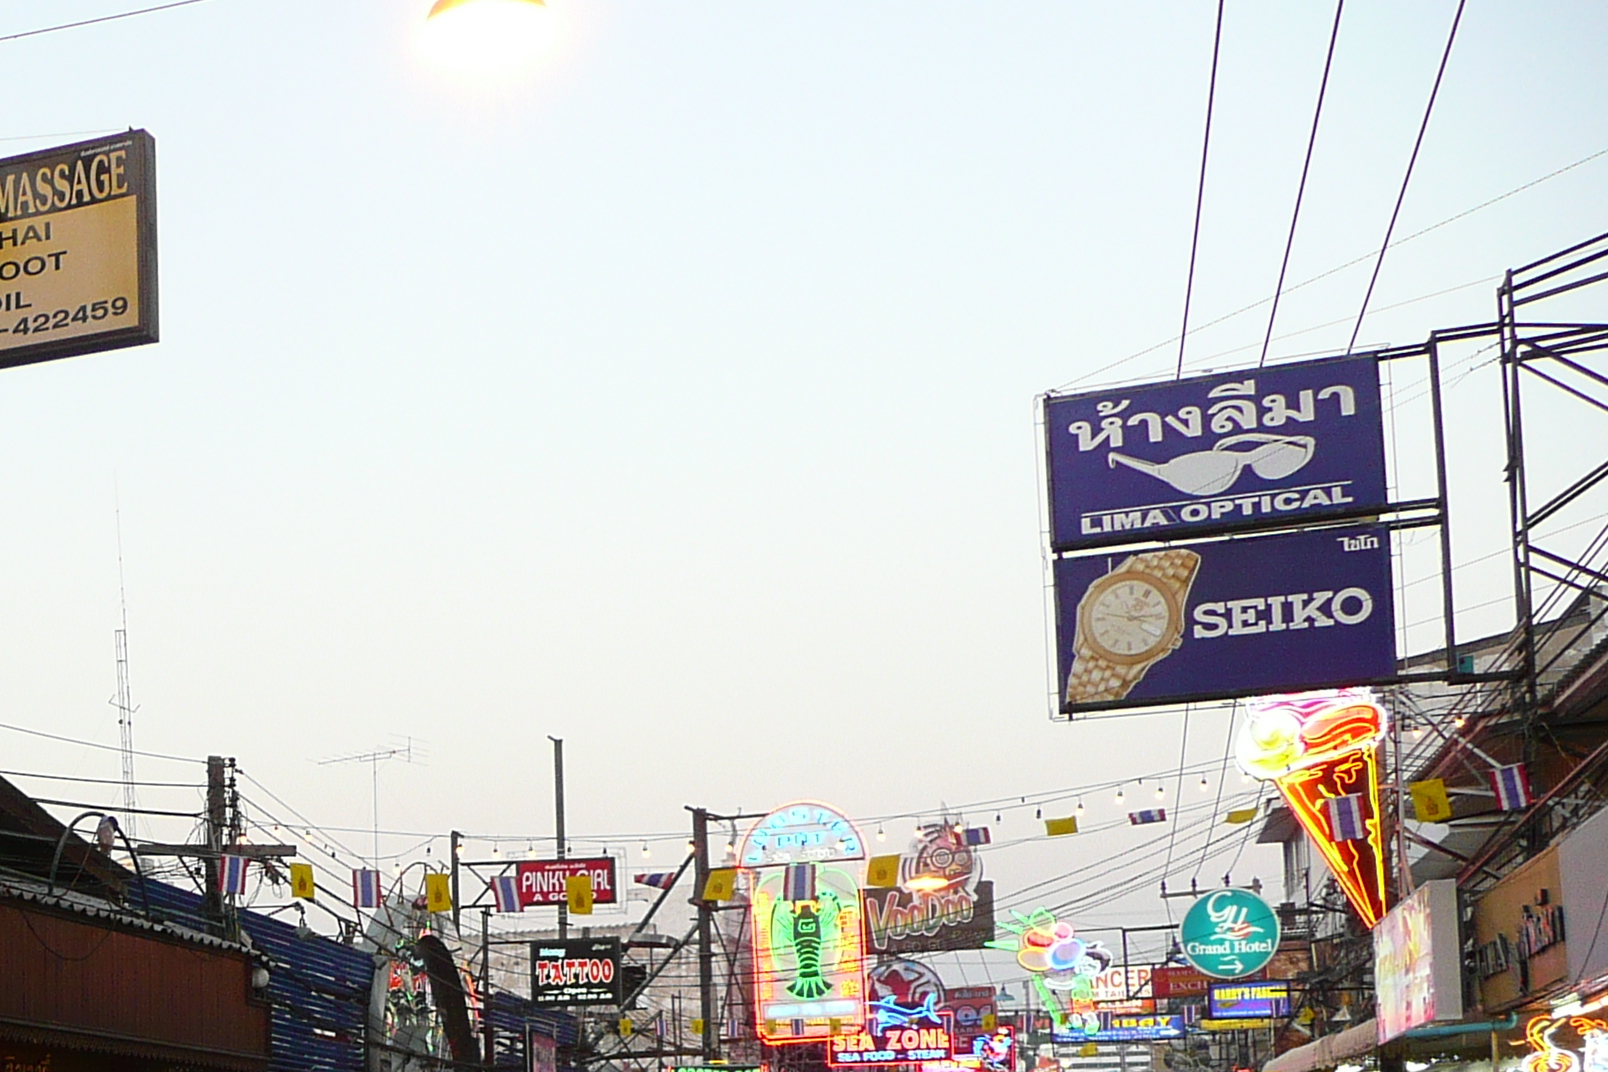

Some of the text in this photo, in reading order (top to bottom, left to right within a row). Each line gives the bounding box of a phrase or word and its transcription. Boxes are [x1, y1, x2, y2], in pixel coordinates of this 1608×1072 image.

[1068, 379, 1357, 452] ห้างลีมา
[1080, 486, 1354, 536] LIMA OPTICAL
[1193, 586, 1373, 639] SEIKO
[522, 870, 567, 893] PINKY
[1187, 939, 1273, 955] Grand Hotel
[535, 958, 614, 986] TATTOO
[832, 1029, 950, 1052] SEA ZONE
[837, 1052, 861, 1062] SEA
[863, 1050, 896, 1061] FOOD
[907, 1049, 946, 1060] STEAK
